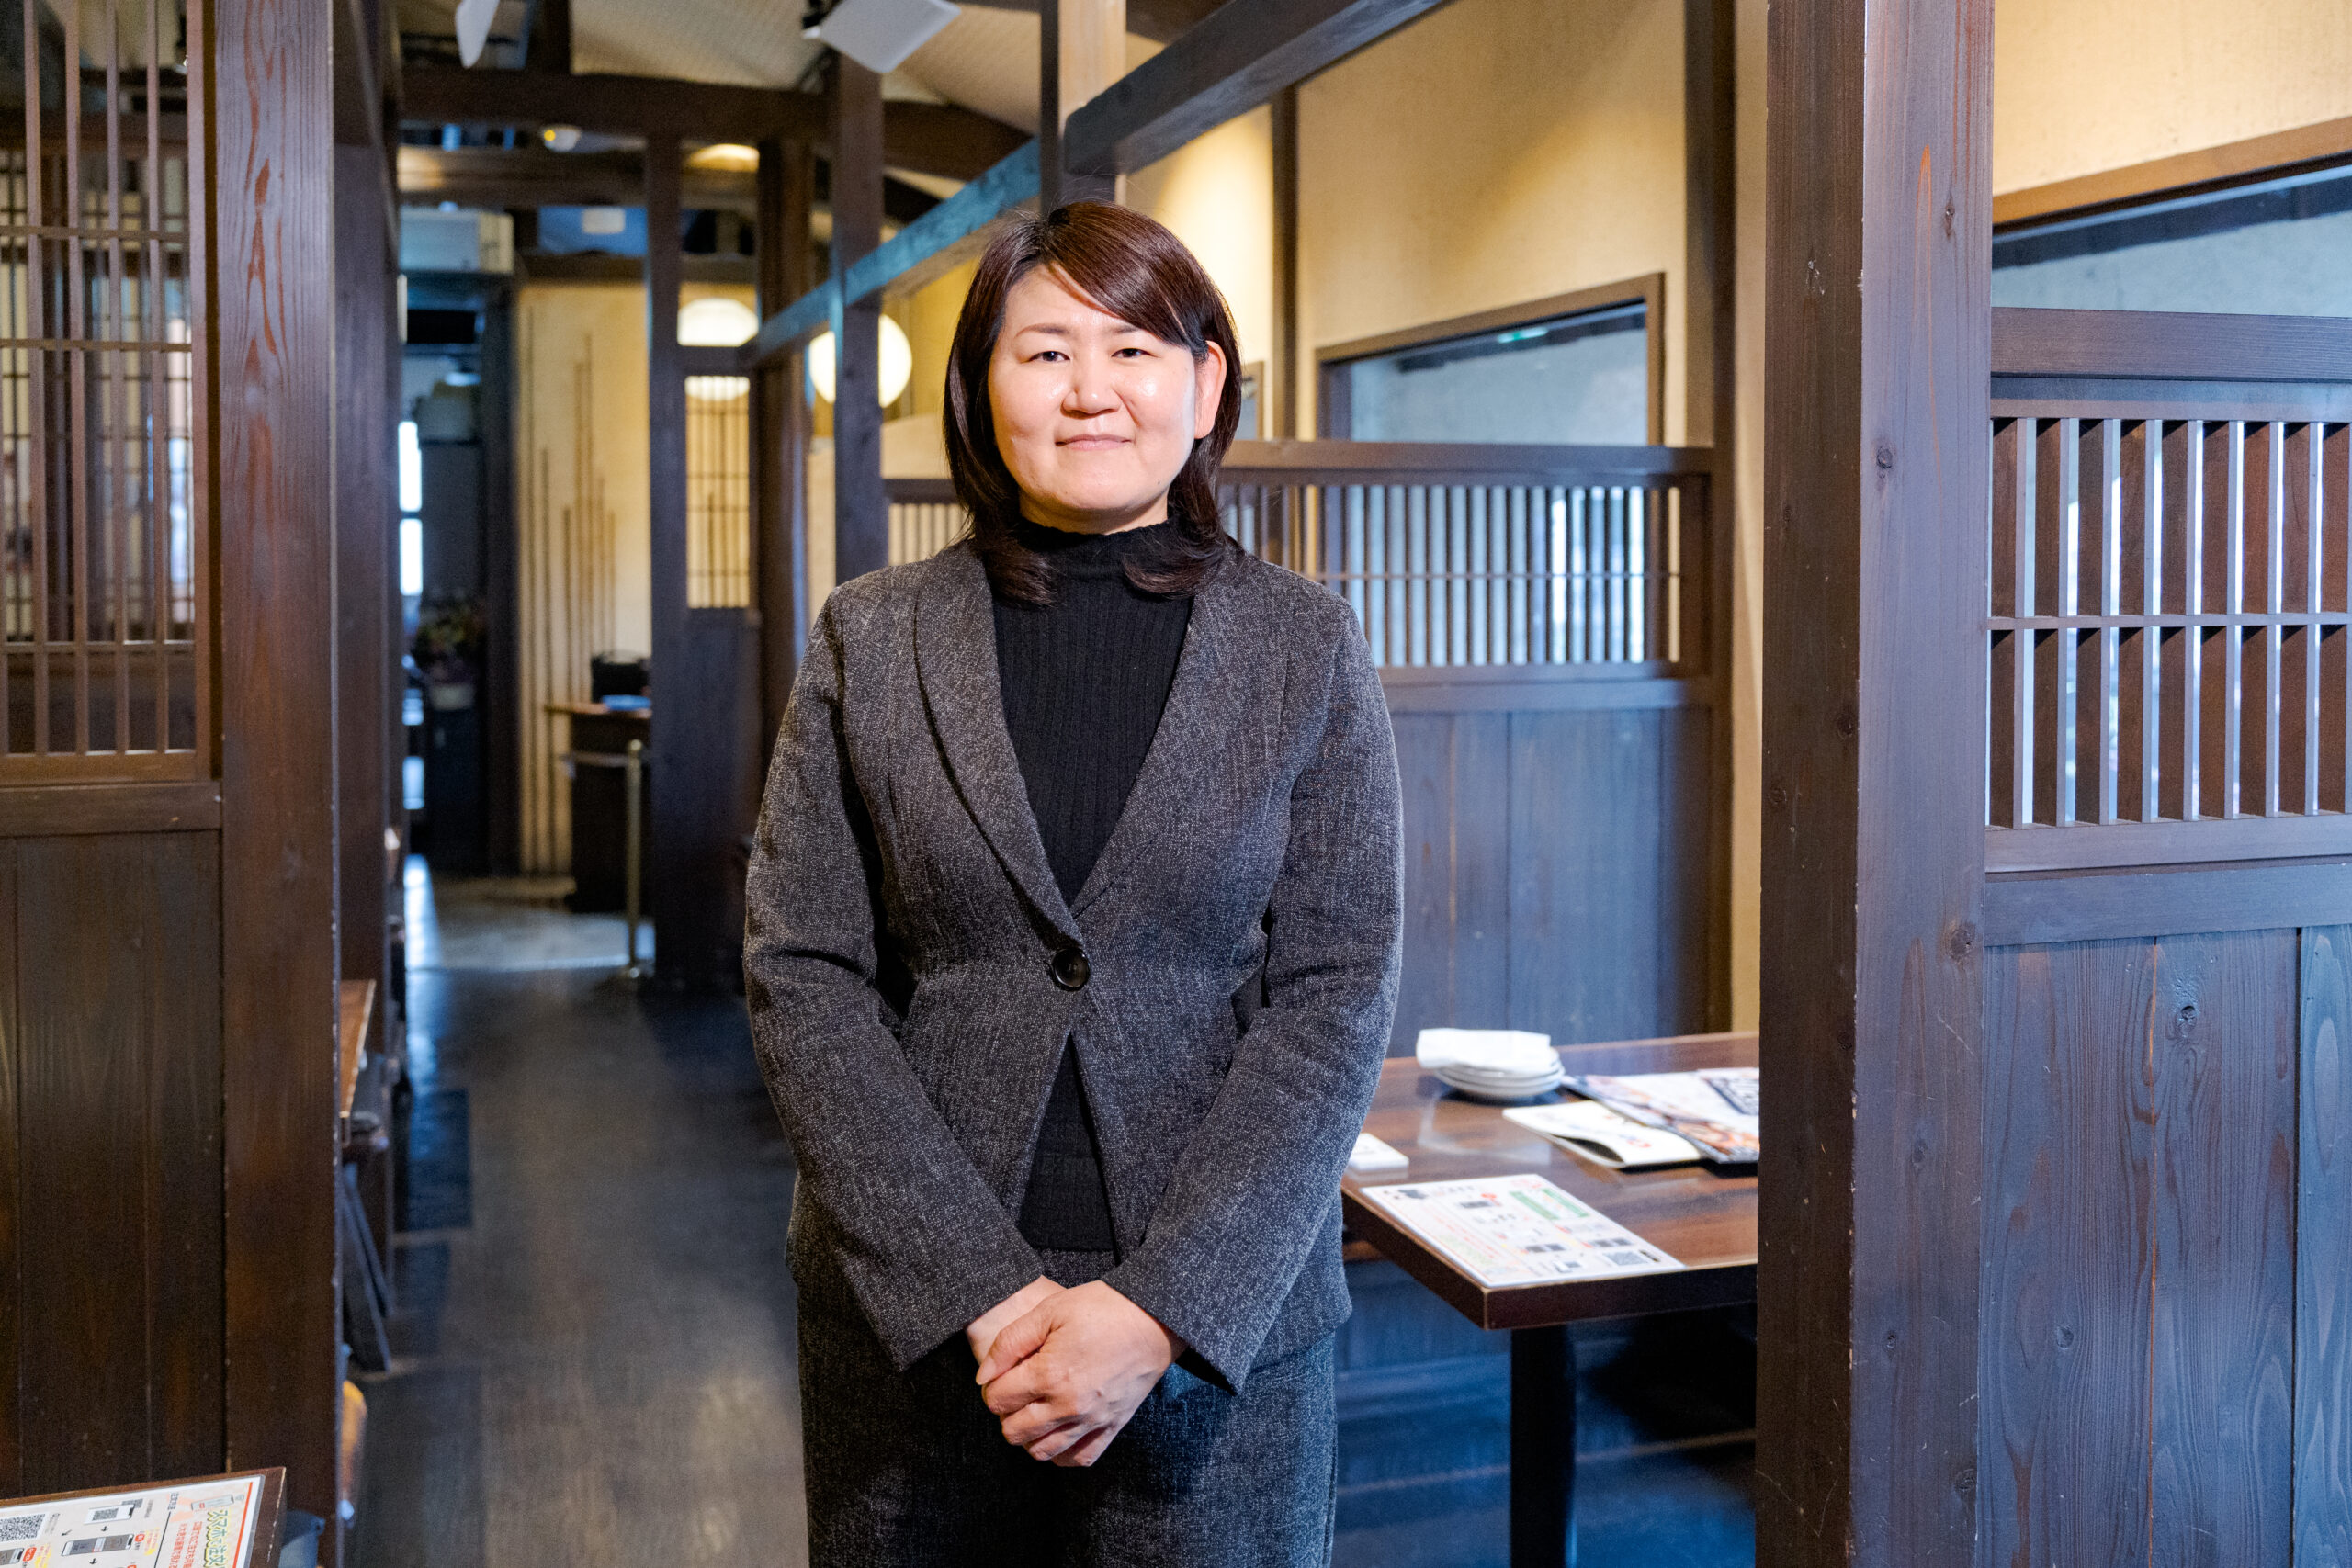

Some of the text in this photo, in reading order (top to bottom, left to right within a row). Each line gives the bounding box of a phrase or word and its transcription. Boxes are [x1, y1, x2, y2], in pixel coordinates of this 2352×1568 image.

[208, 1509, 229, 1568] スマホで注文
